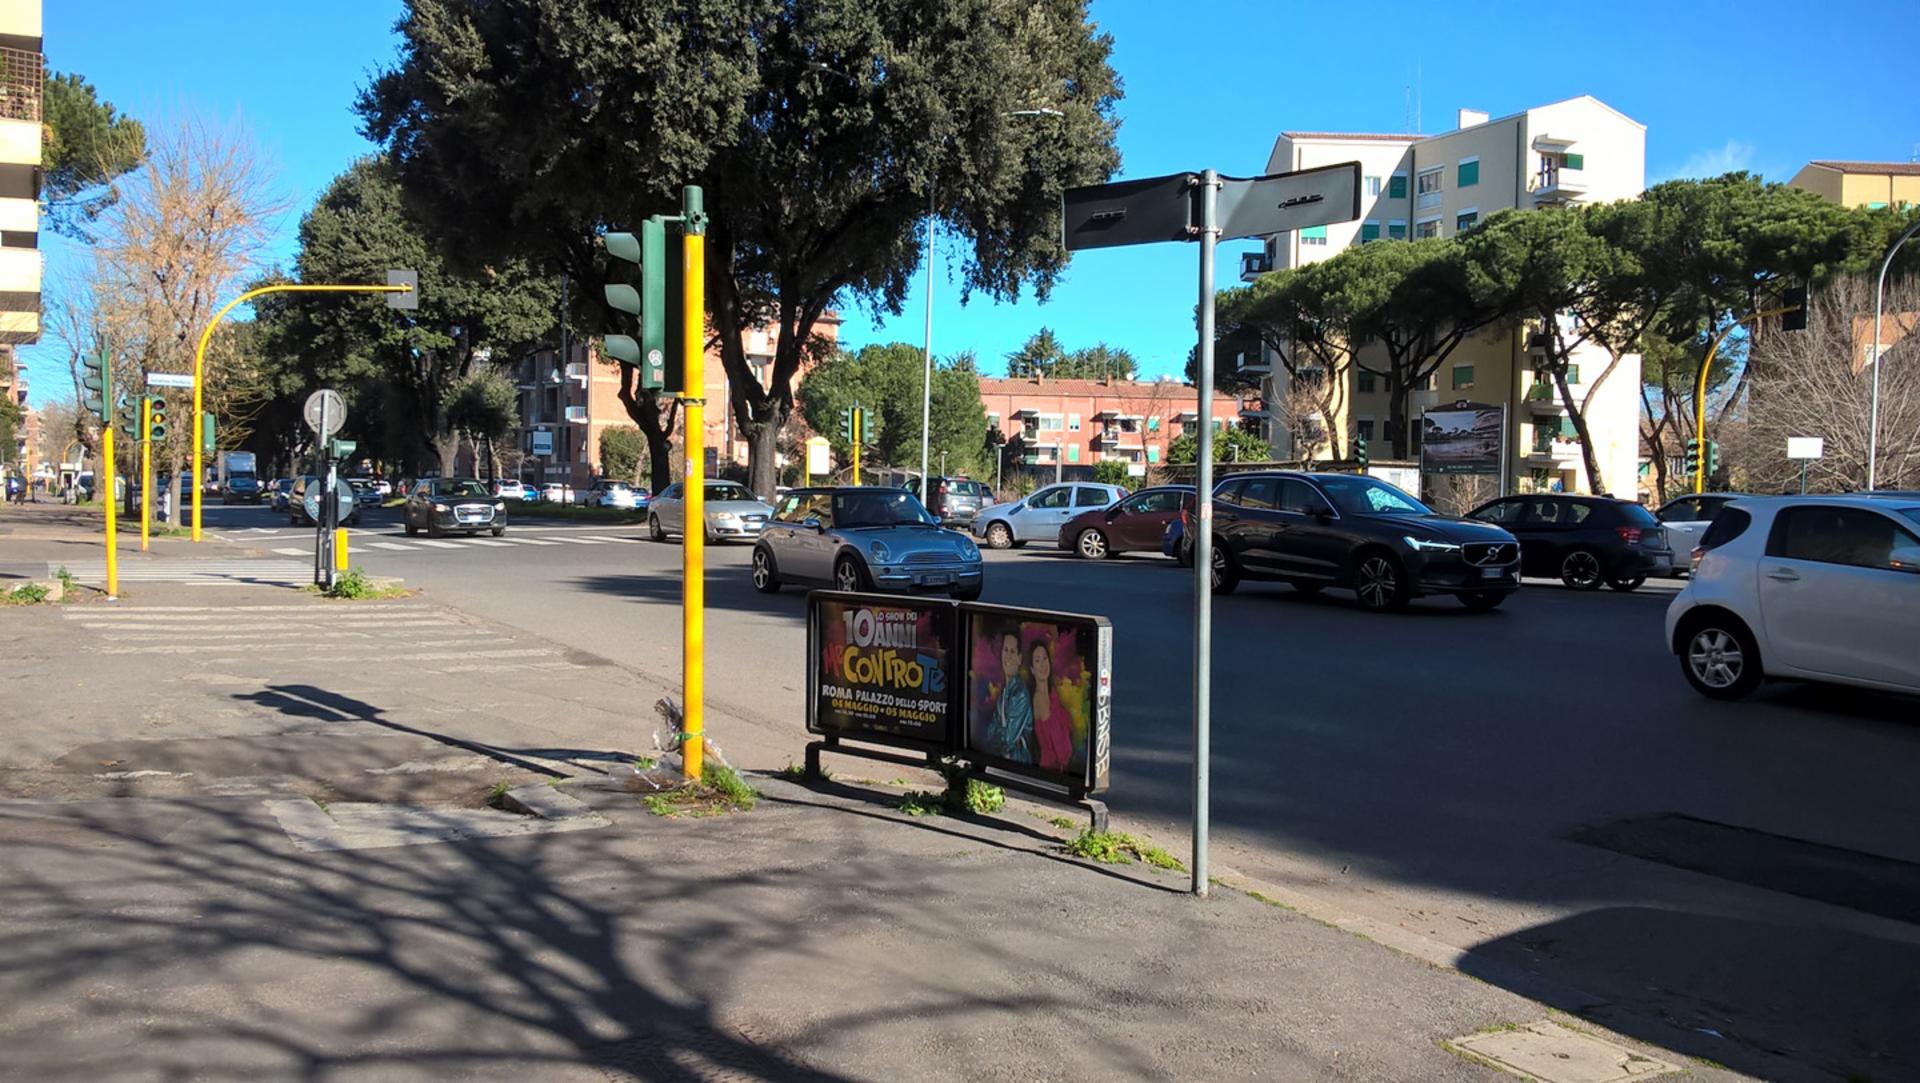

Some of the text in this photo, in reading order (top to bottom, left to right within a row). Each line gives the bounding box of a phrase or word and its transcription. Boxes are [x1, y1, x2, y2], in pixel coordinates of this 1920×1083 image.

[842, 608, 917, 649] 10 ANNI
[843, 645, 923, 689] CONTRO
[822, 684, 947, 714] ROMA PALAZZO DELLO SPORT
[844, 701, 879, 714] MAGGIO
[898, 709, 936, 723] MAGGIO
